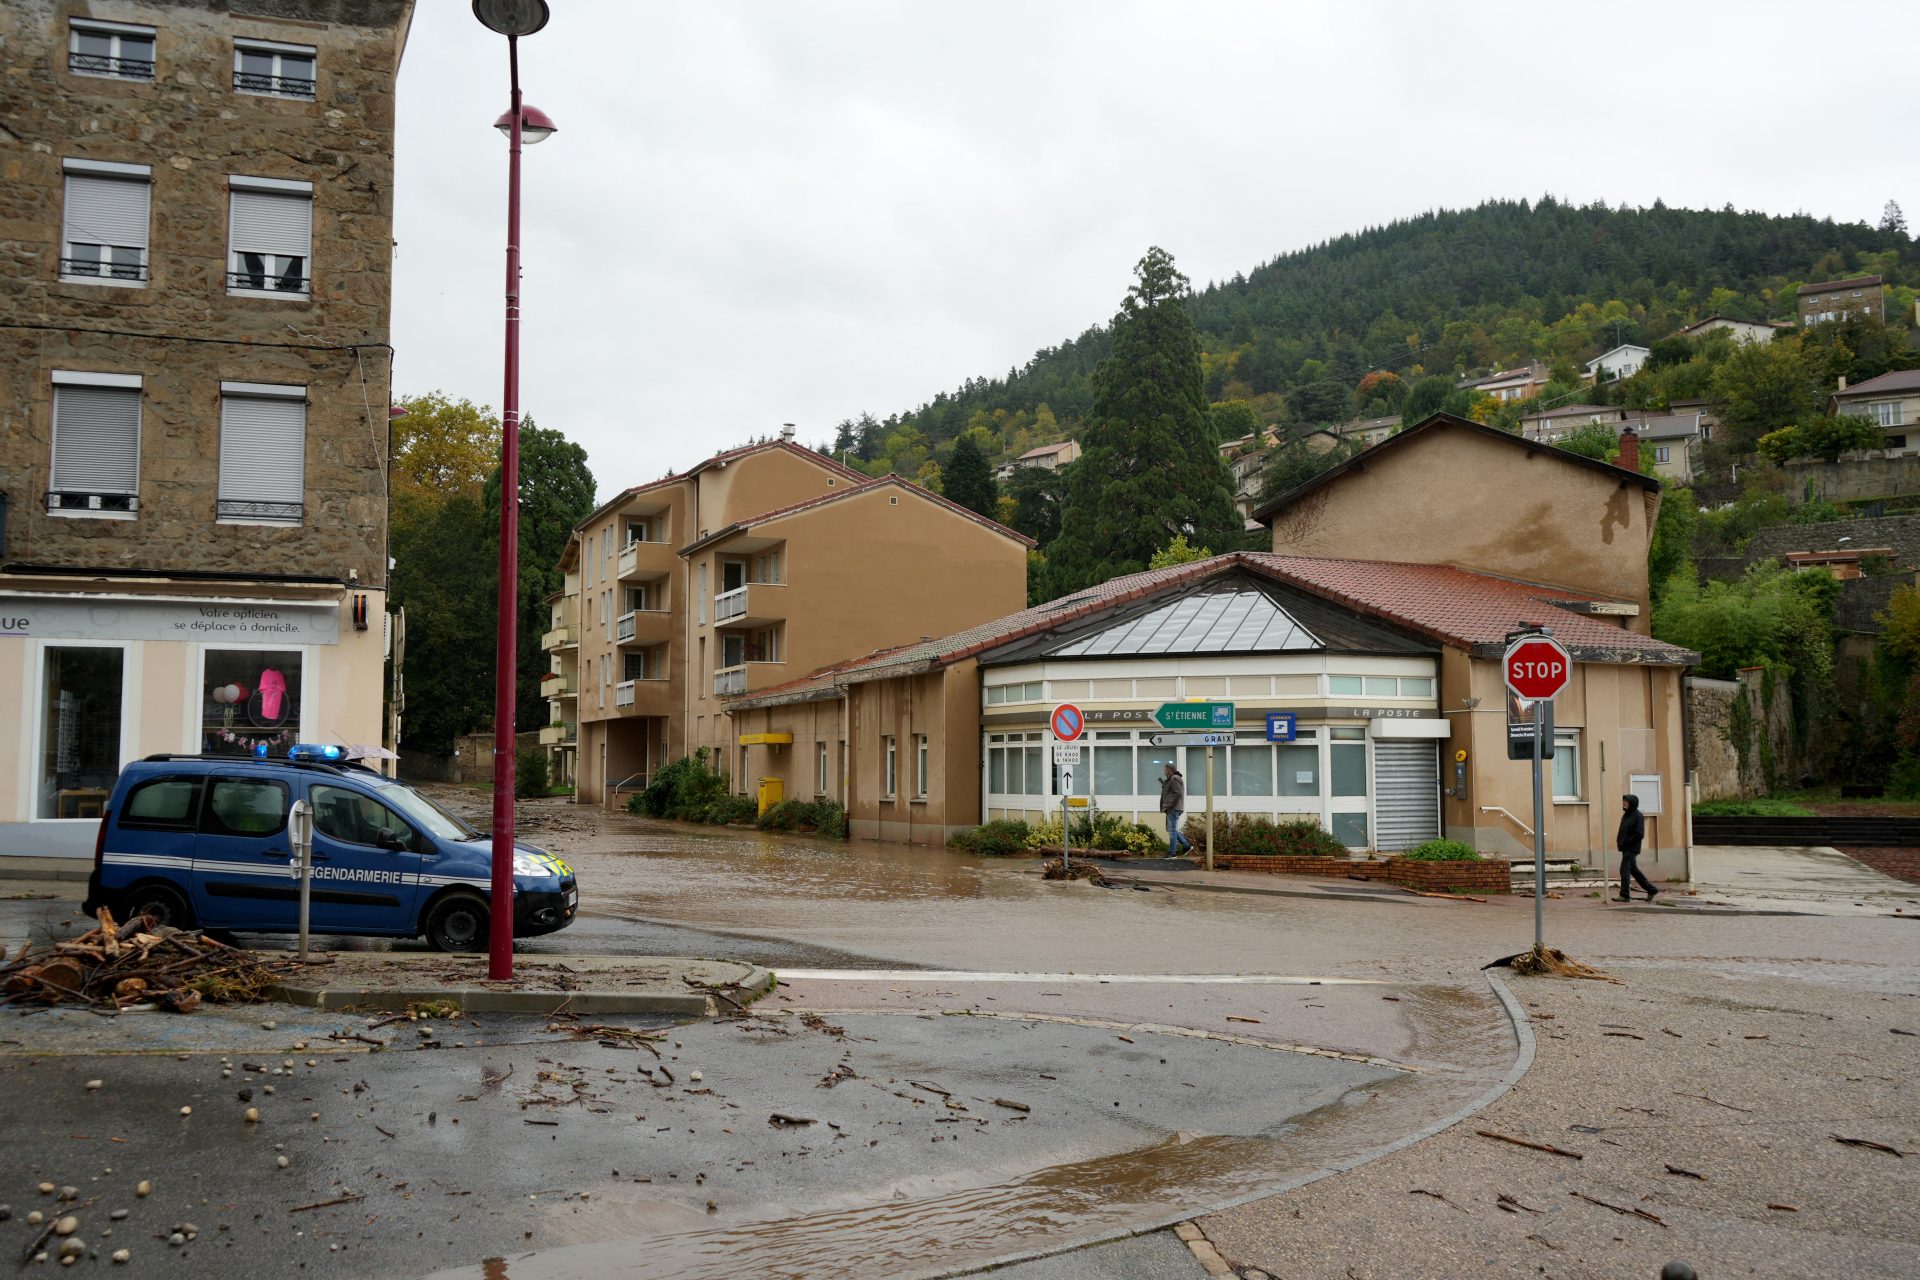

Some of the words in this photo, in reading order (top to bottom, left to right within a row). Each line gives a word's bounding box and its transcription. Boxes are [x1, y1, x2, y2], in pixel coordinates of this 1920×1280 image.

[200, 607, 229, 617] Votre
[233, 607, 277, 620] opticien
[0, 617, 30, 630] ue
[174, 622, 186, 630] se
[190, 621, 236, 632] déplace
[239, 622, 247, 631] à
[251, 623, 300, 633] domicile.
[1513, 662, 1562, 678] STOP
[1084, 712, 1103, 720] LA
[1112, 711, 1152, 719] POST
[1175, 710, 1207, 720] ÉTIENNE
[1378, 709, 1420, 717] POSTE
[1204, 735, 1232, 743] GRAIX
[315, 866, 401, 884] GENDARMERIE
